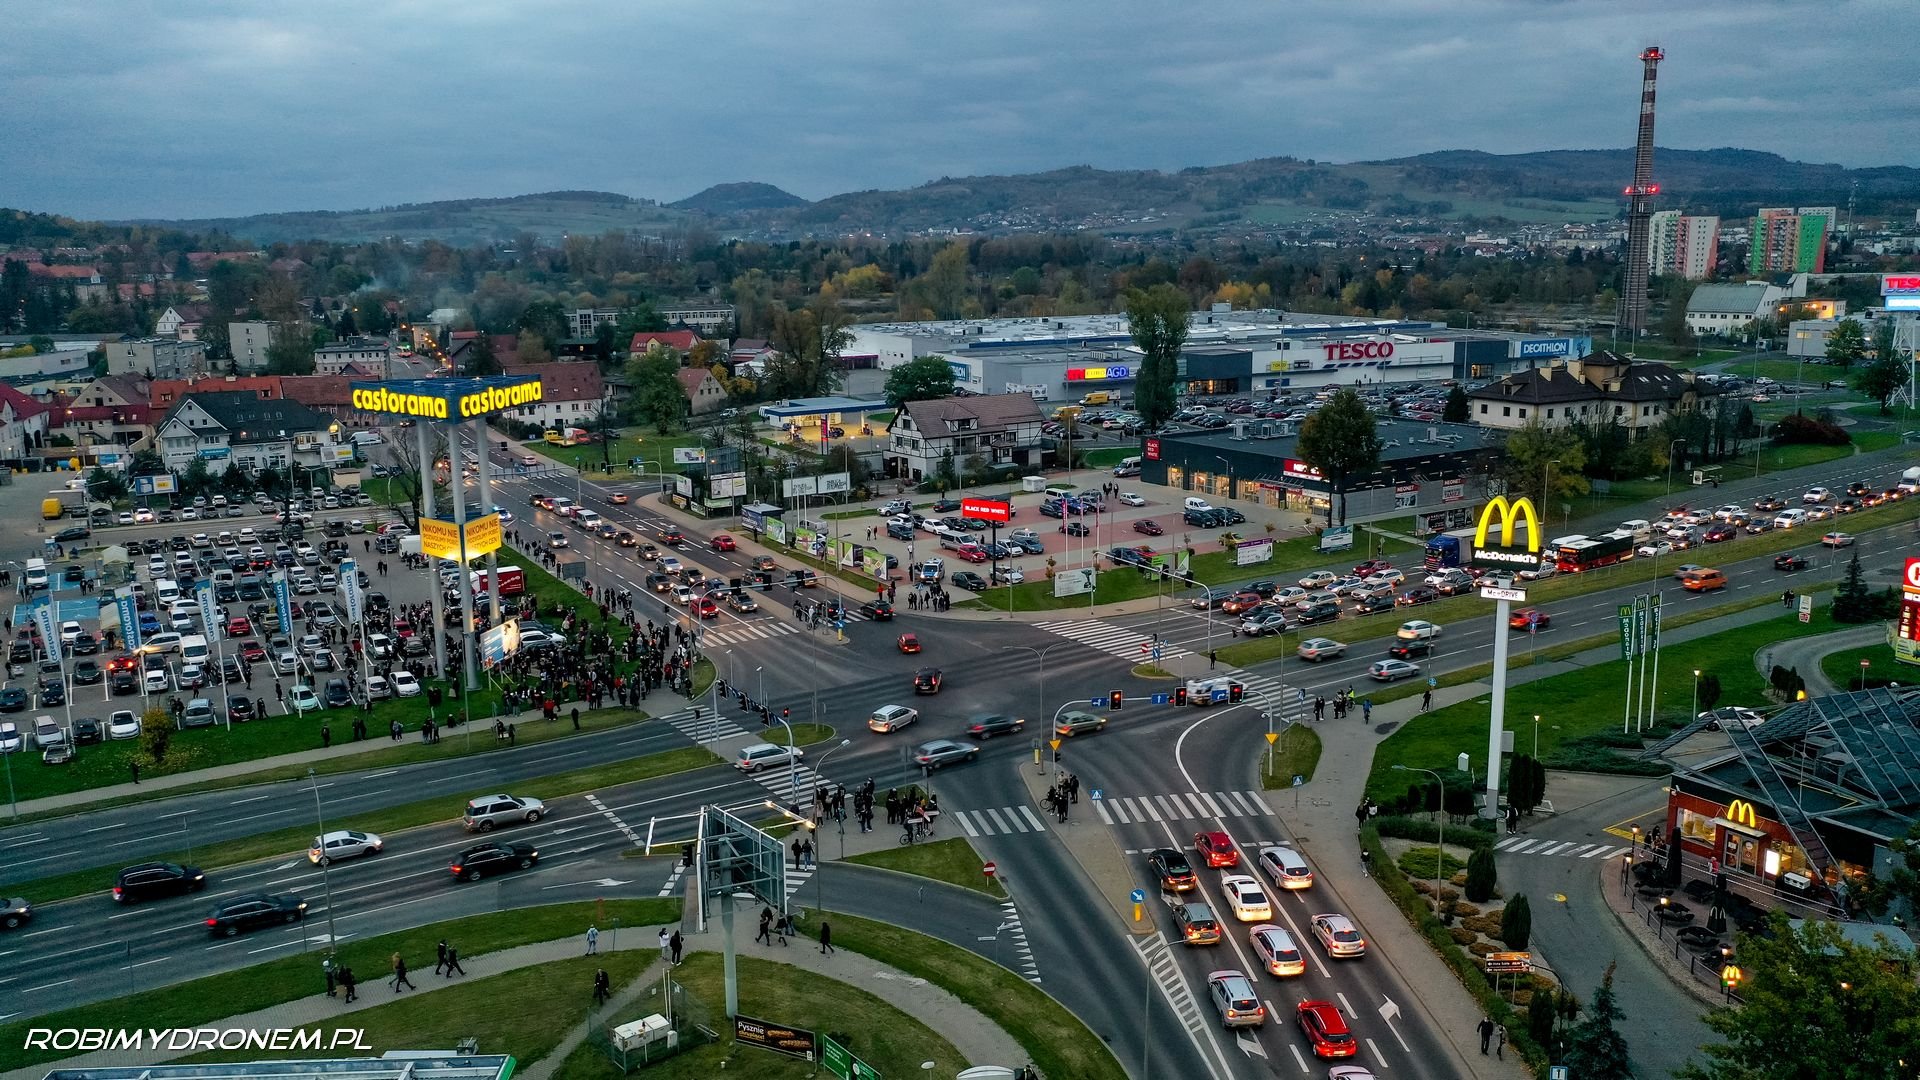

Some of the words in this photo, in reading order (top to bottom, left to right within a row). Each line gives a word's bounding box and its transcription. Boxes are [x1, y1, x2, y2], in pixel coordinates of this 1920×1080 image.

[1323, 341, 1394, 360] TESCO
[1523, 342, 1567, 354] DECATHLON
[1107, 367, 1126, 378] AGD
[353, 387, 448, 419] castorama
[460, 381, 542, 417] castorama
[964, 505, 980, 513] BLACK
[980, 506, 990, 514] RED
[990, 507, 1006, 515] WHITE
[422, 524, 447, 537] NIKOMU
[447, 529, 458, 539] NIE
[466, 523, 488, 537] NIKOMU
[488, 519, 498, 527] NIE
[1474, 550, 1538, 564] McDonald's
[738, 1021, 764, 1035] Pysznie
